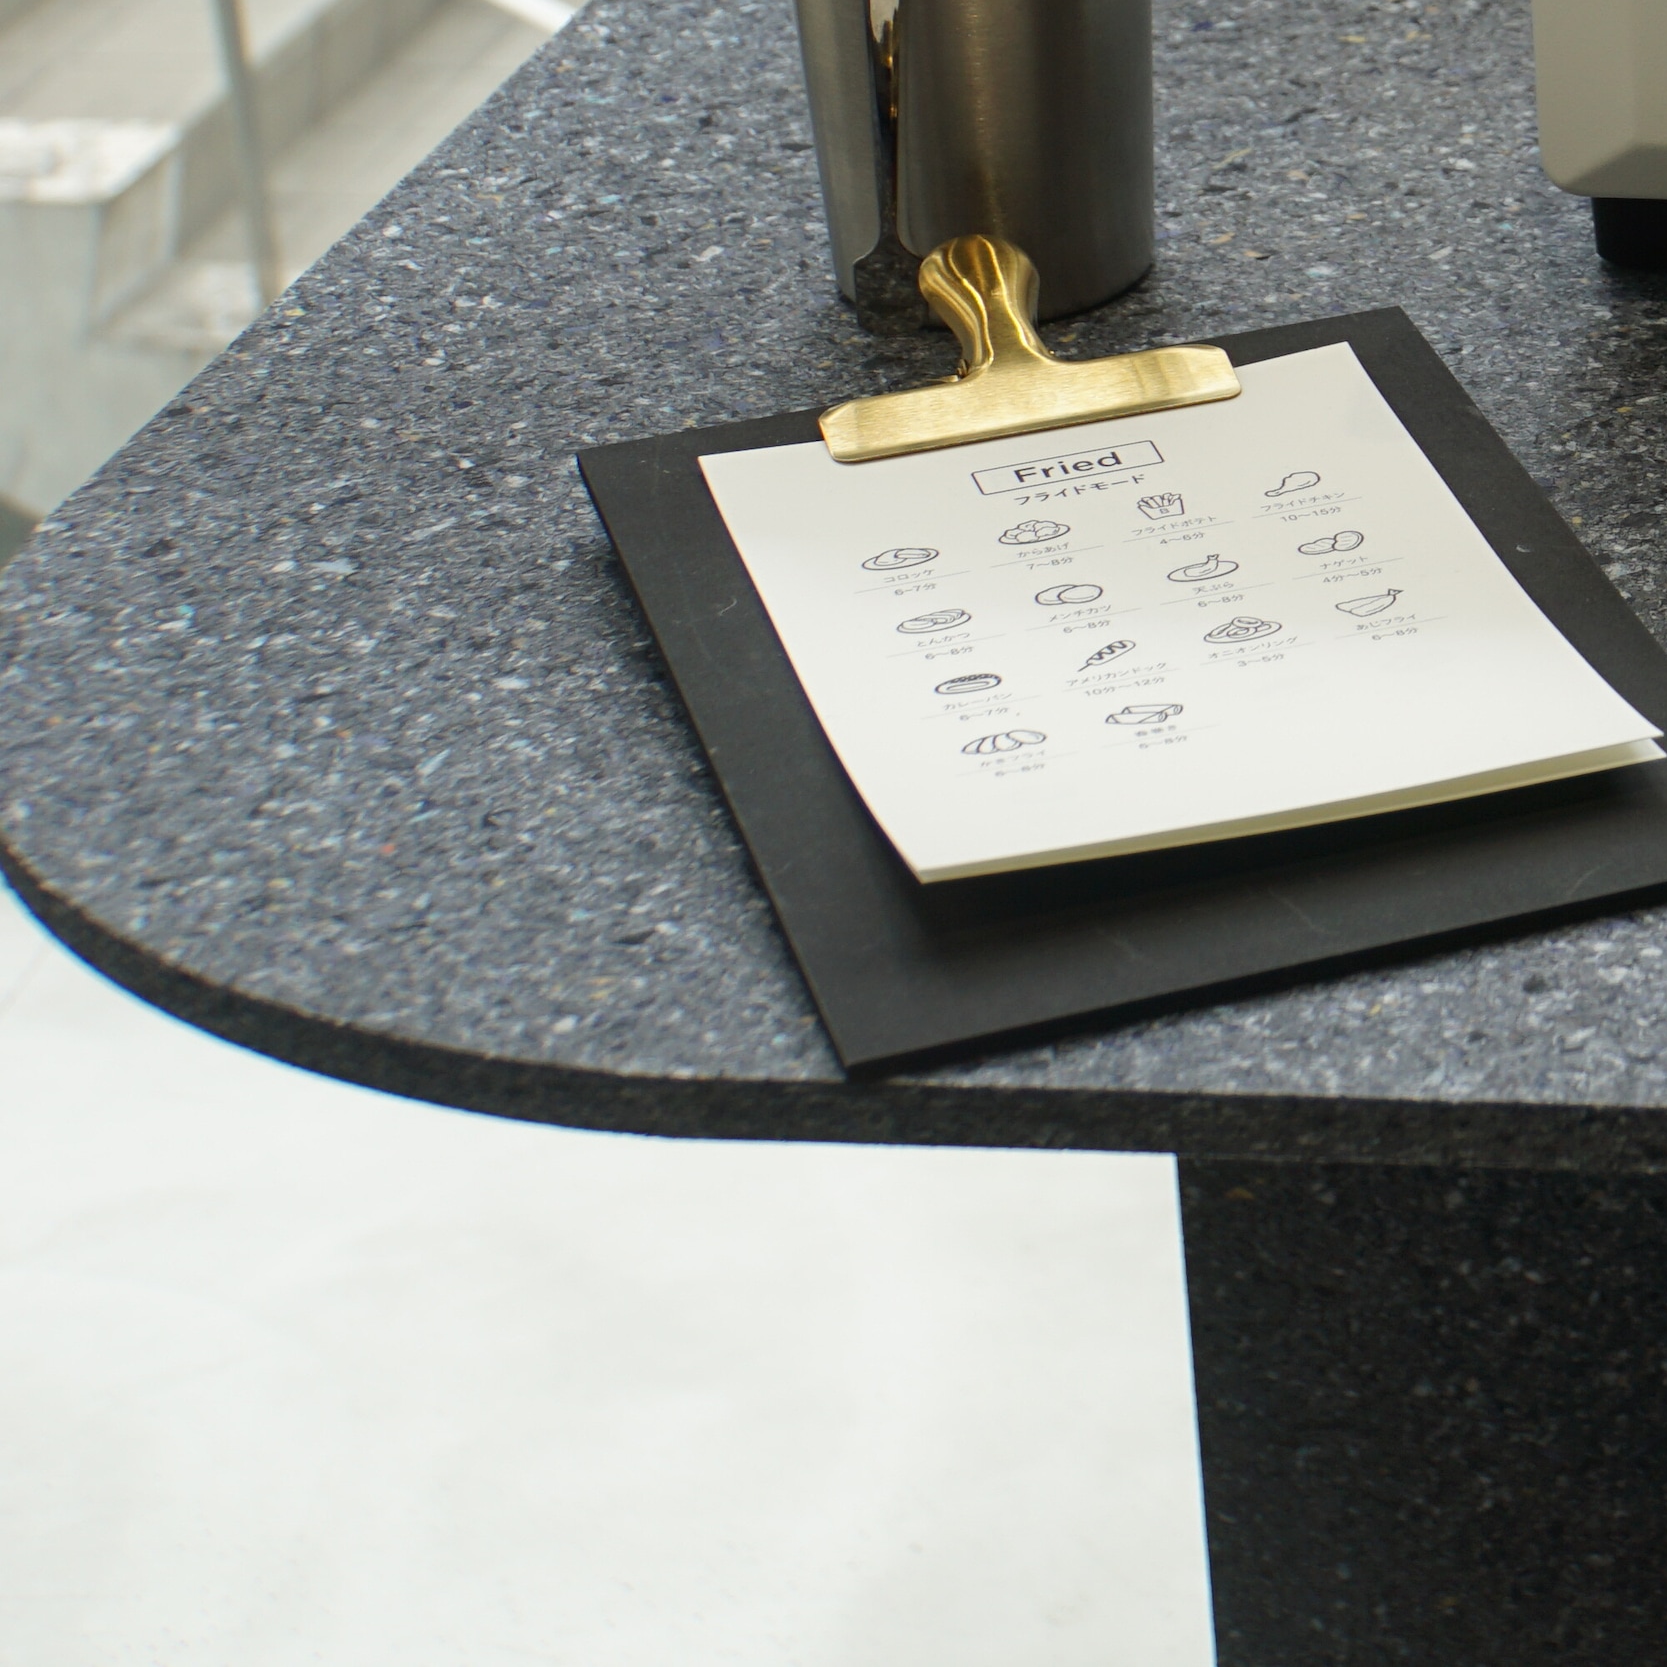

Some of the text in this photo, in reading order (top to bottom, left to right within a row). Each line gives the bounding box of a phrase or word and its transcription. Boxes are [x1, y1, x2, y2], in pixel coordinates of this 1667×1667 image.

[1013, 451, 1123, 484] Fried
[1013, 473, 1146, 506] フライドモード
[1260, 491, 1346, 512] フライドチキン
[1131, 515, 1217, 536] フライドポテト
[1016, 541, 1070, 558] からあげ
[1319, 555, 1369, 570] ナゲット
[883, 568, 936, 584] コロッケ
[1048, 604, 1112, 623] メンチカツ
[916, 631, 971, 648] とんかつ
